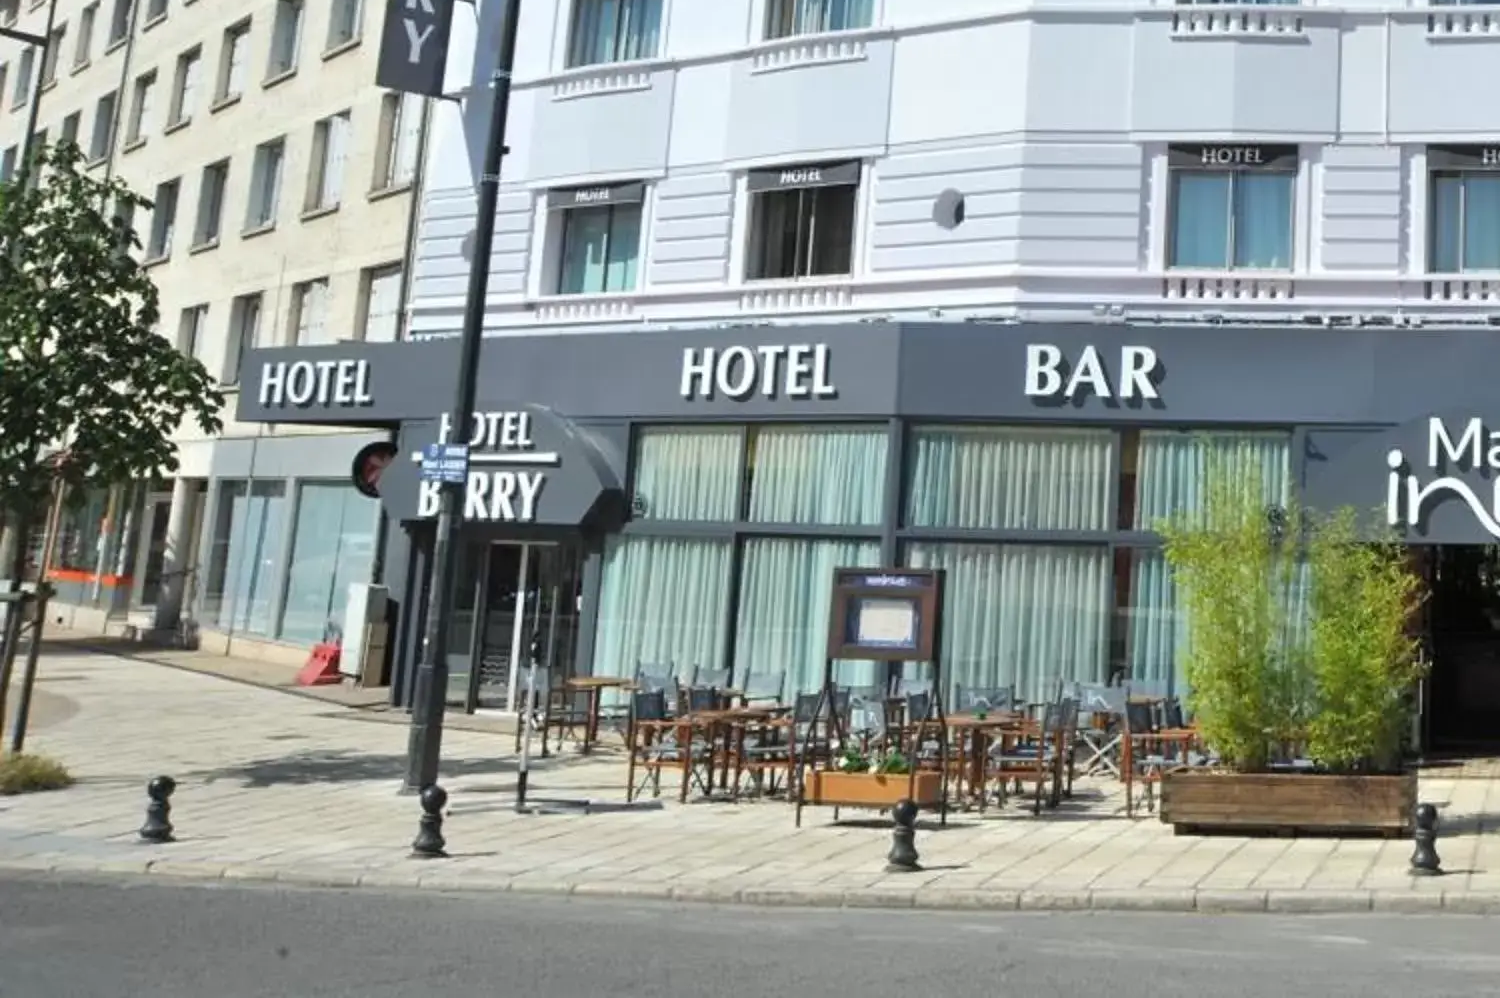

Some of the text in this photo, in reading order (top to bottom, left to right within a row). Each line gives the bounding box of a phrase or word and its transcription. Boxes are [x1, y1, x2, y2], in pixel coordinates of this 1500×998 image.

[1202, 148, 1263, 164] HOTEL
[259, 360, 371, 403] HOTEL
[679, 344, 834, 397] HOTEL
[1024, 344, 1158, 399] BAR
[417, 471, 544, 520] BRRY
